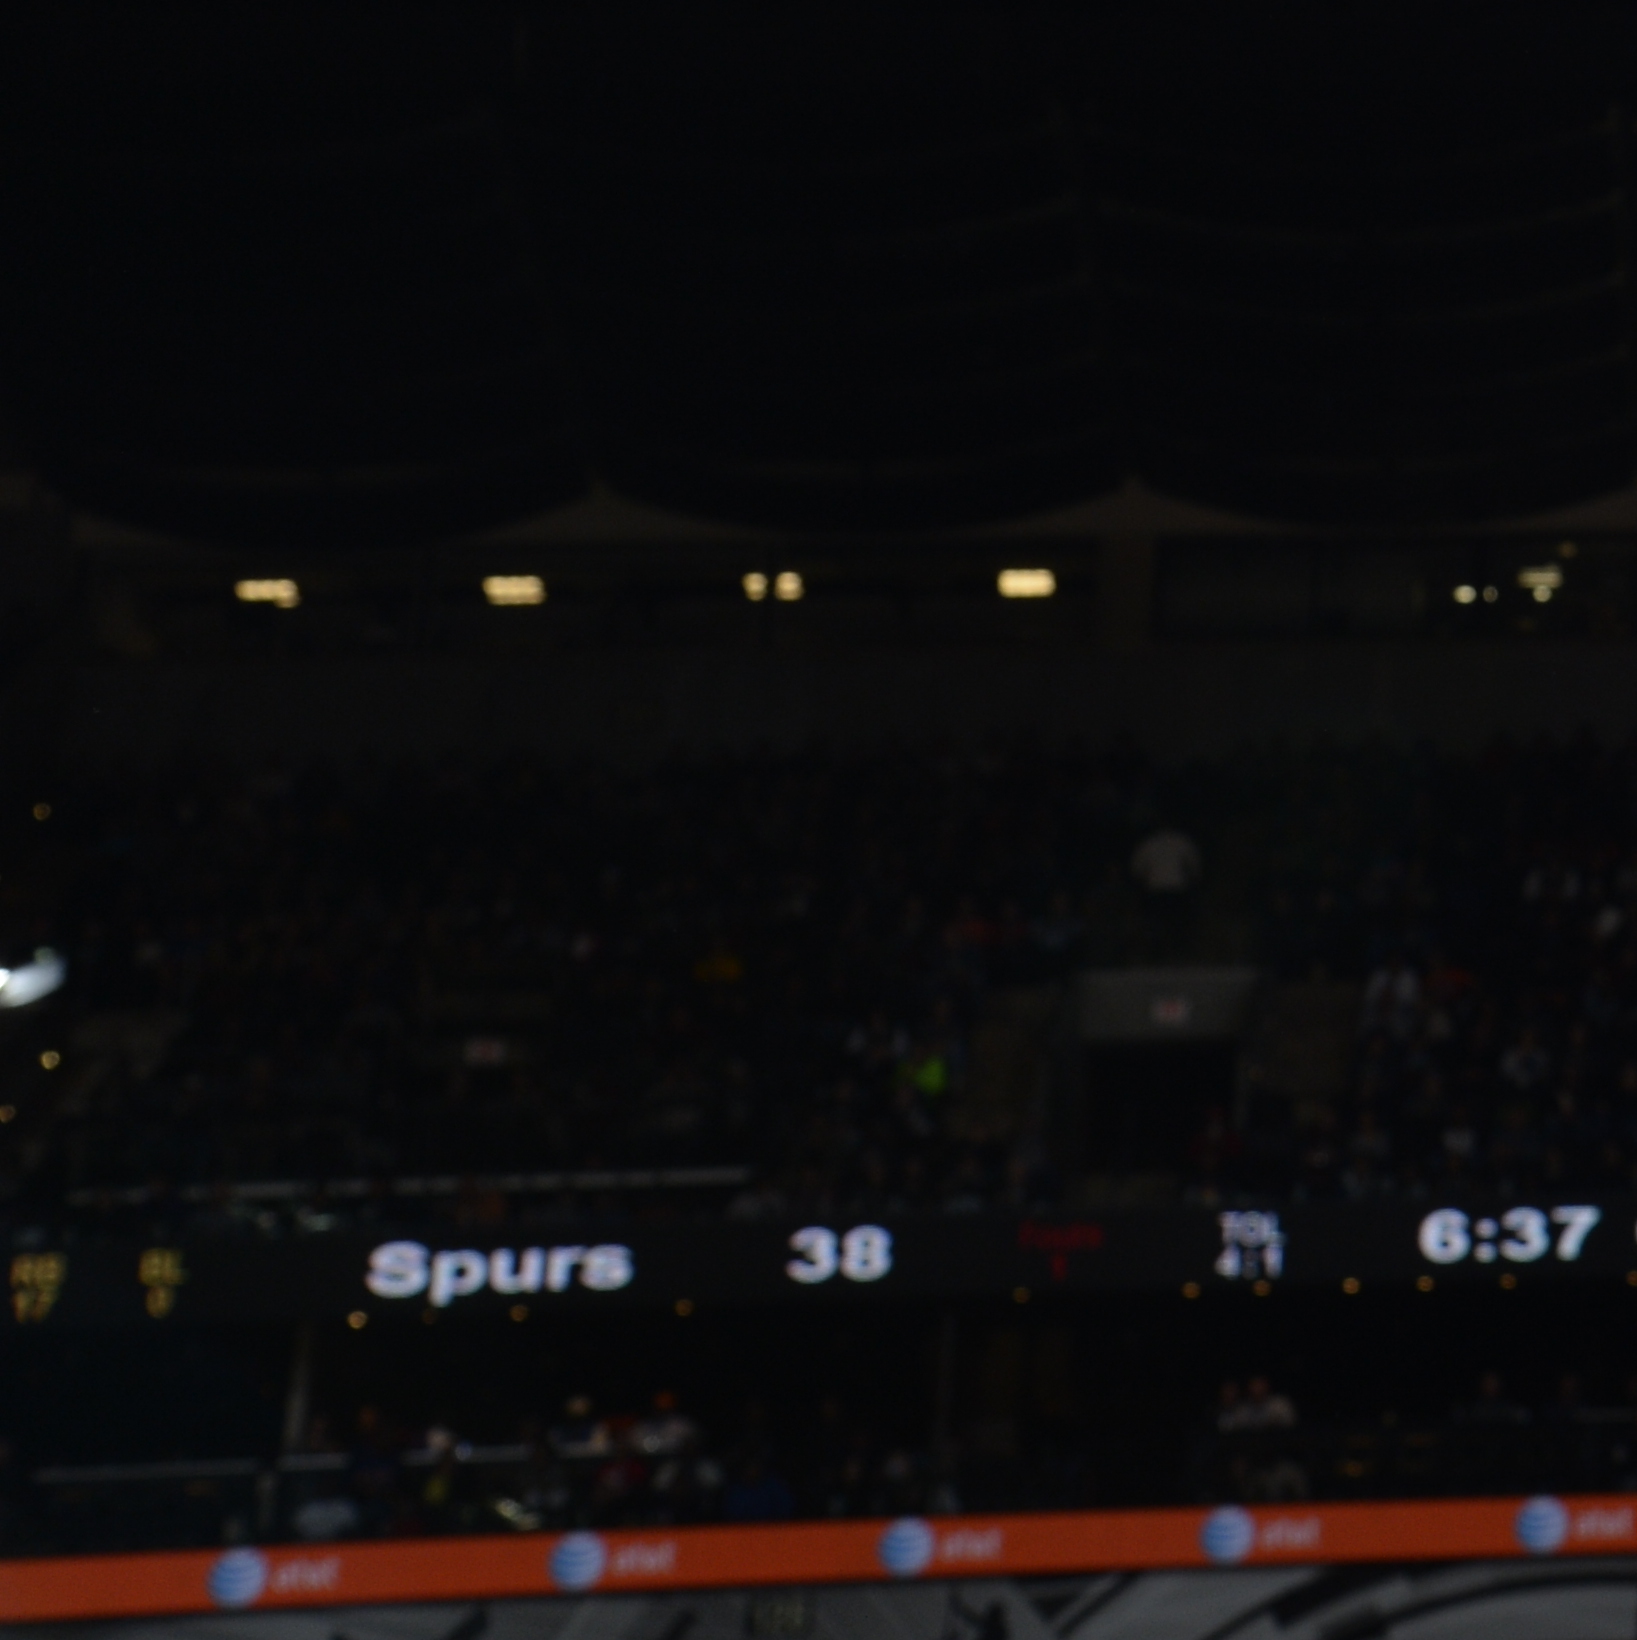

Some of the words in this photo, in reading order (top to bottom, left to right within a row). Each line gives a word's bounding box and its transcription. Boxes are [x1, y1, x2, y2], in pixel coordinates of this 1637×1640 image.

[786, 1224, 892, 1284] 38
[1417, 1206, 1601, 1264] 6:37
[364, 1239, 636, 1307] Spurs
